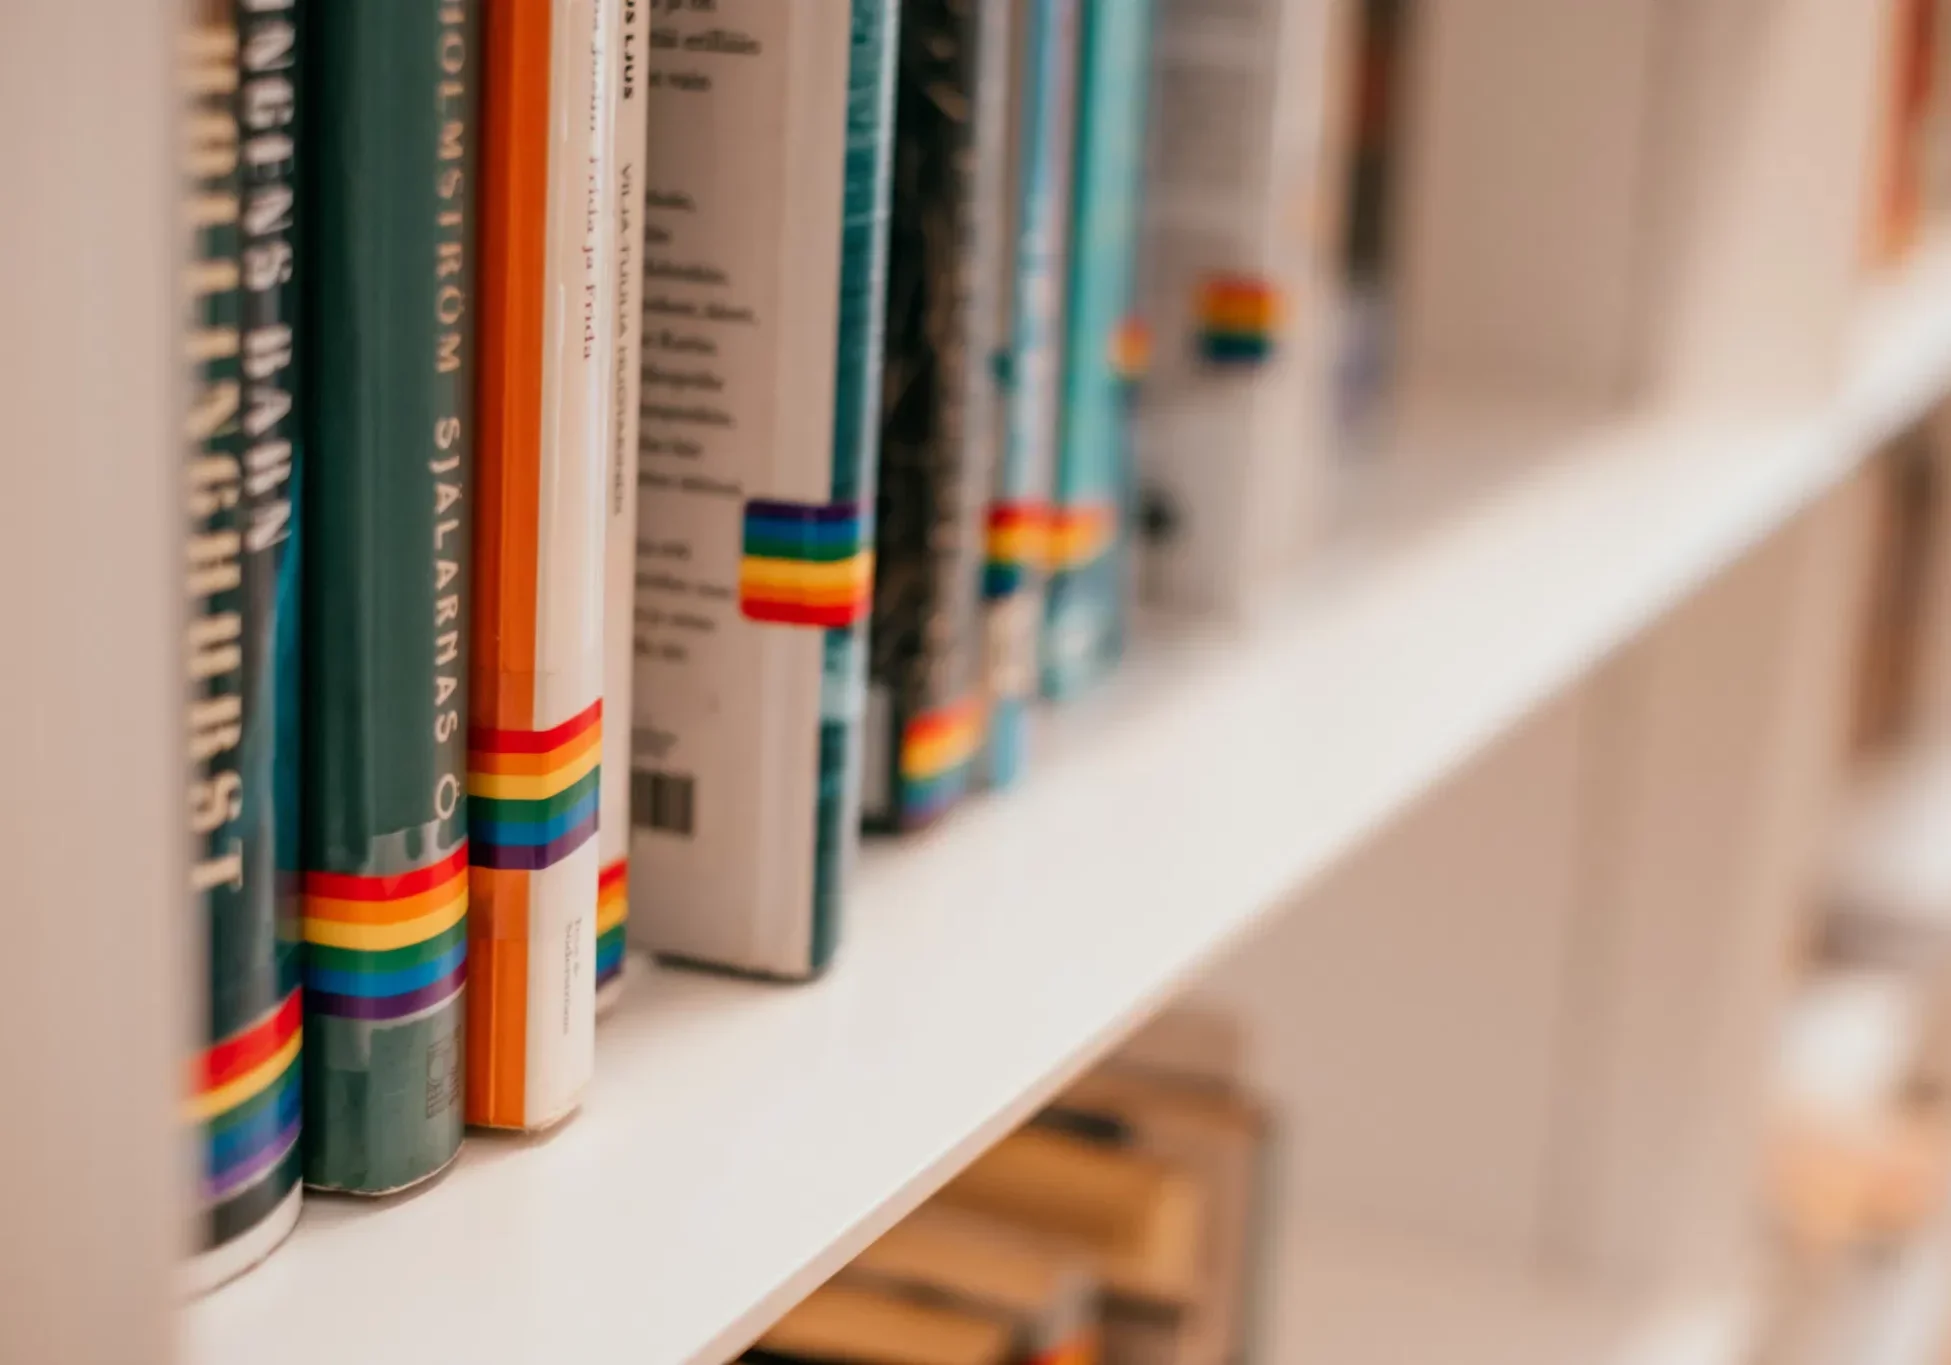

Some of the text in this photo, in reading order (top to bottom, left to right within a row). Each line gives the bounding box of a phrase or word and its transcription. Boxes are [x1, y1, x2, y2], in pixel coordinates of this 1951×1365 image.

[623, 33, 638, 100] LJUS
[581, 245, 596, 270] ja
[582, 283, 597, 361] Frida
[243, 325, 293, 552] BARN
[429, 415, 462, 745] SJÄLARNAS
